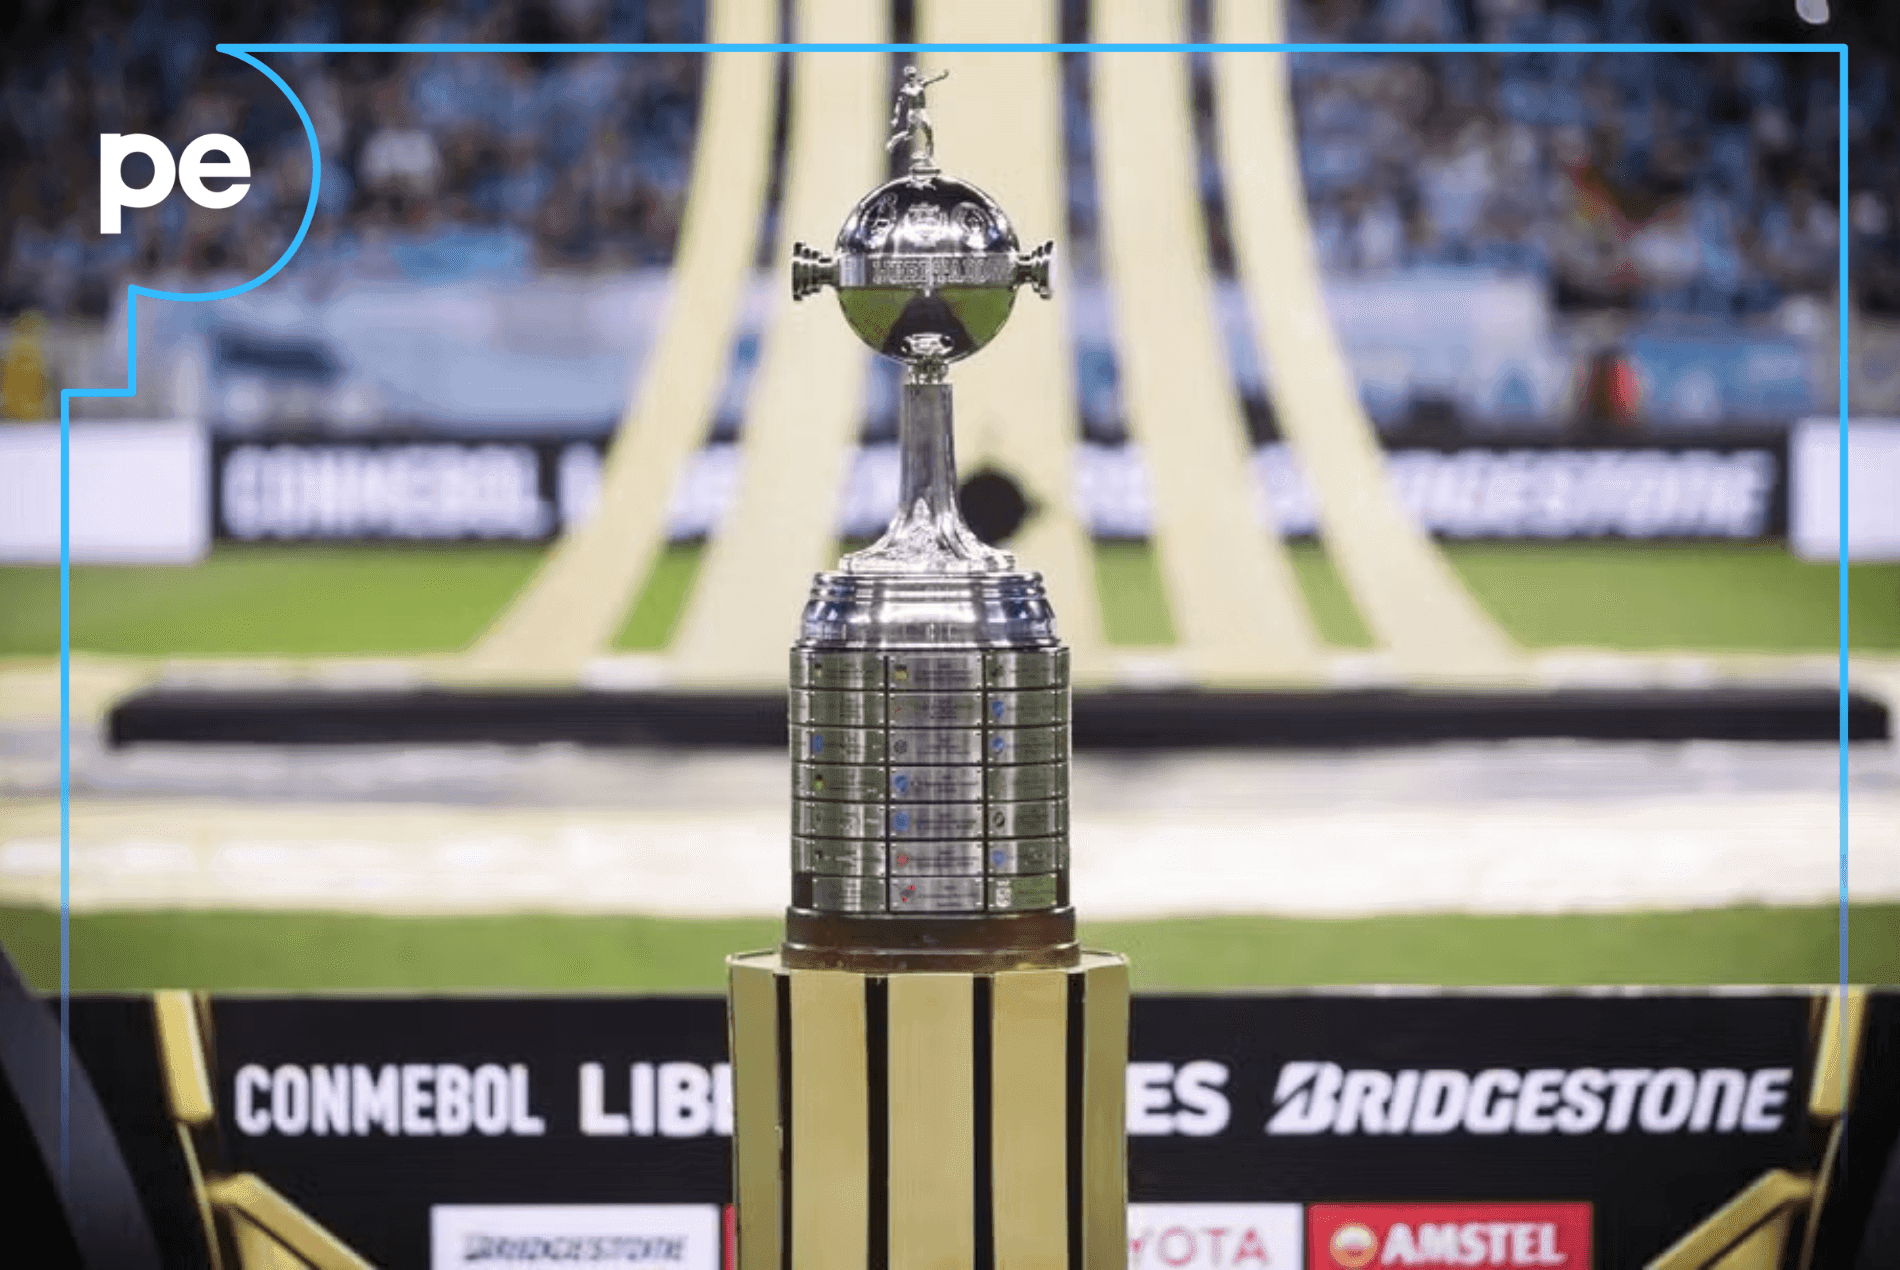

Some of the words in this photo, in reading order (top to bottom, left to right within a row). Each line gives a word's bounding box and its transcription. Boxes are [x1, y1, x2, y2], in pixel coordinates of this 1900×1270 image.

[234, 1063, 546, 1136] CONMEBOL
[1266, 1061, 1792, 1134] BRIDGESTONE
[1381, 1221, 1567, 1266] AMSTEL
